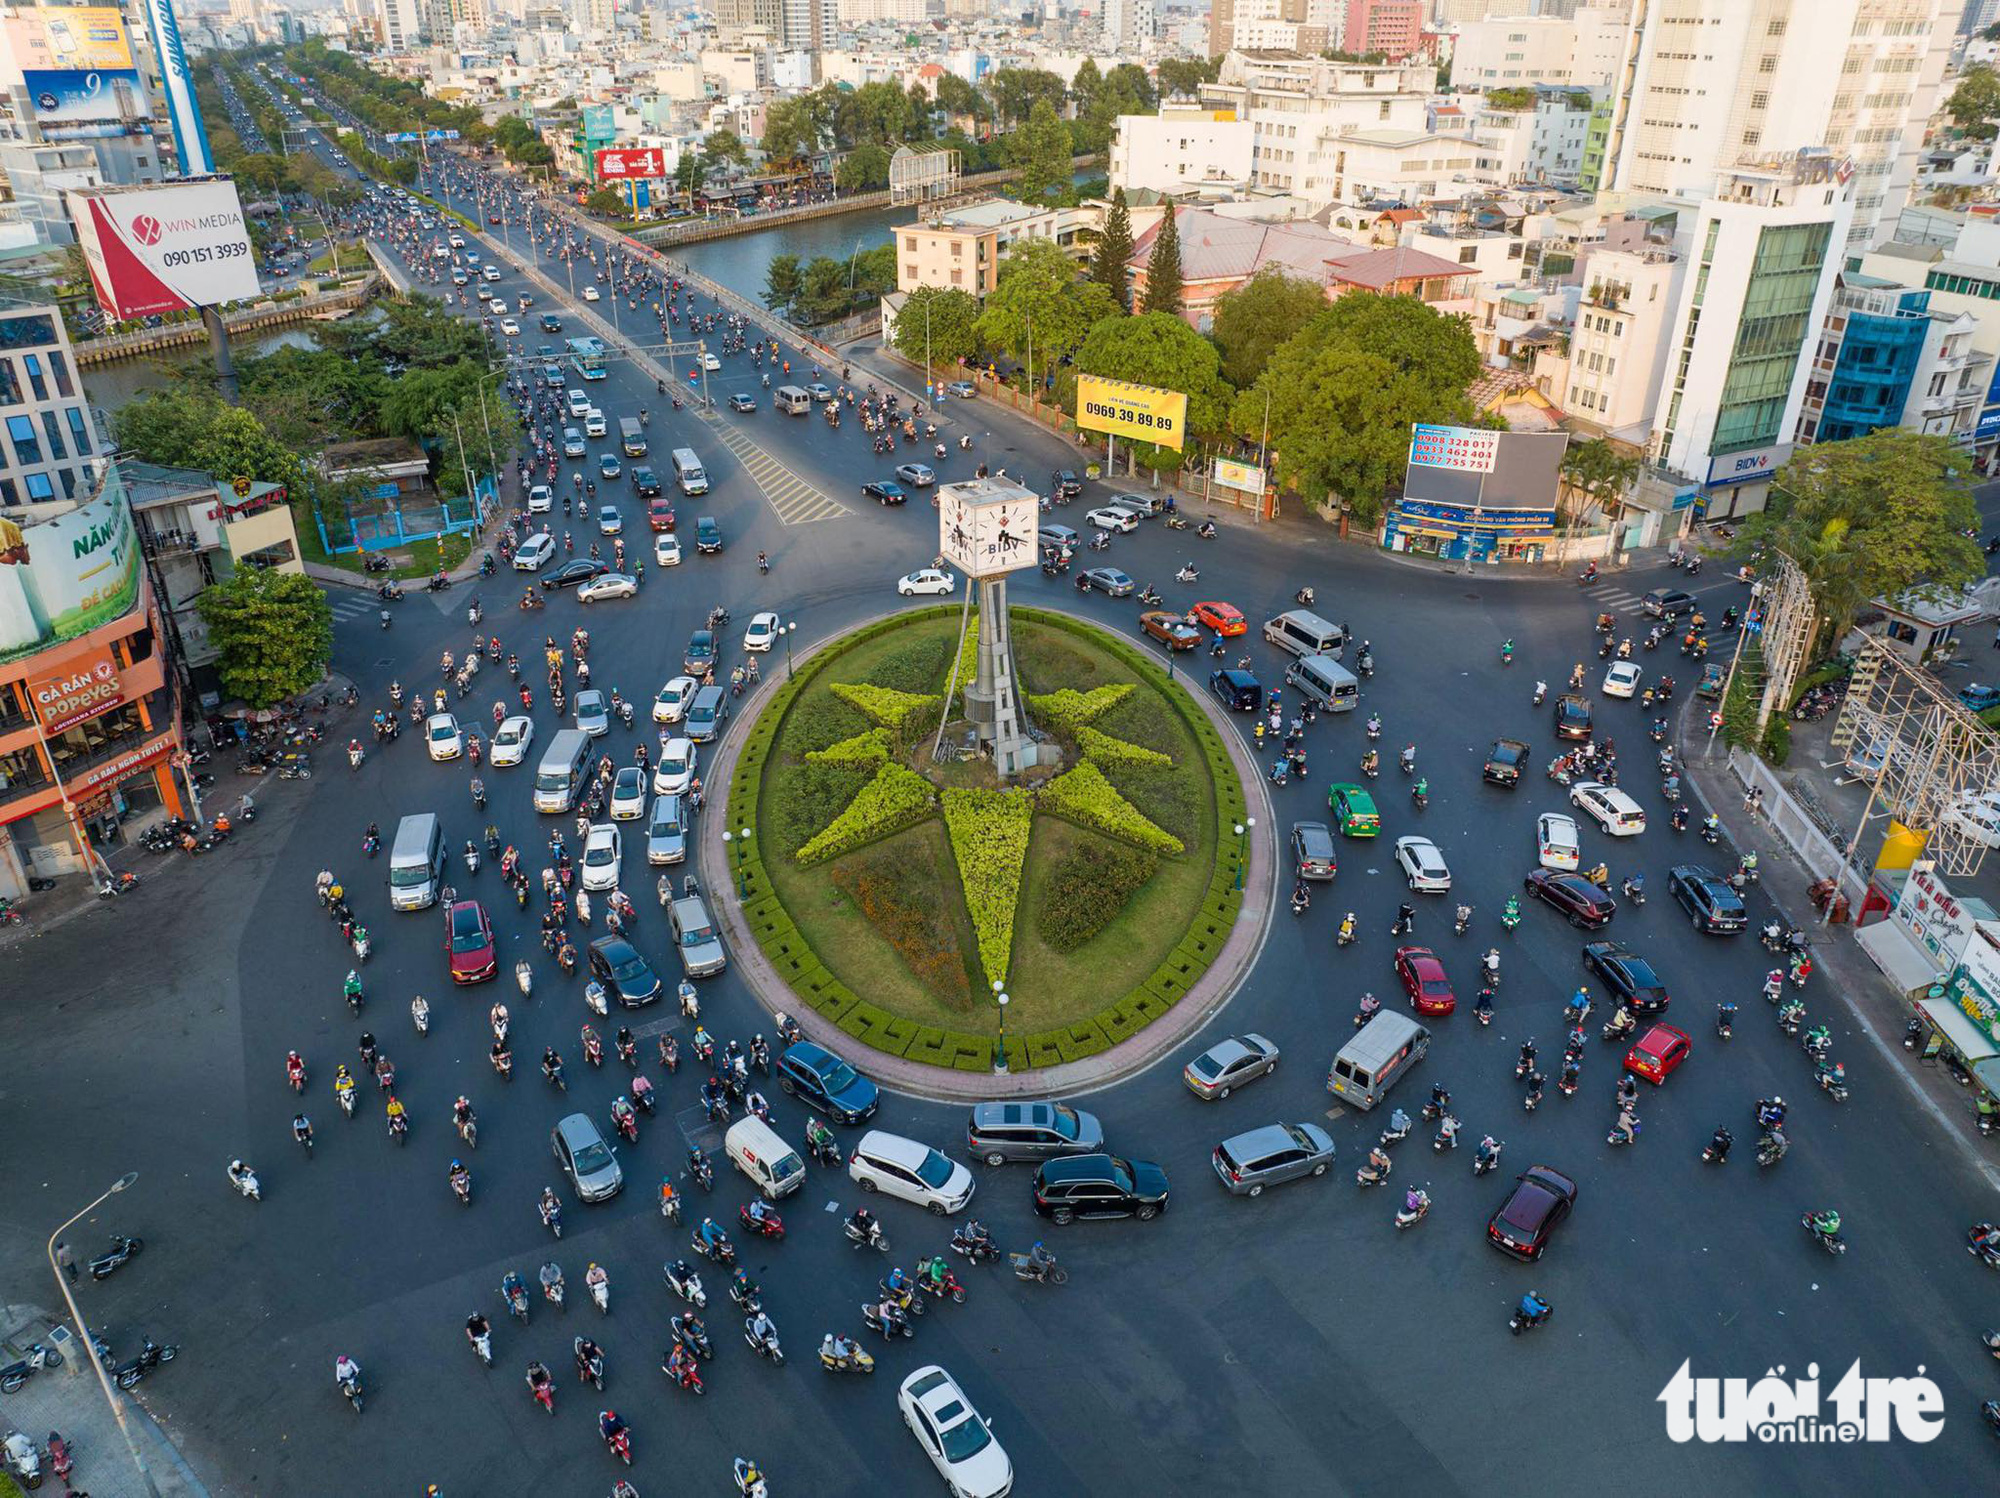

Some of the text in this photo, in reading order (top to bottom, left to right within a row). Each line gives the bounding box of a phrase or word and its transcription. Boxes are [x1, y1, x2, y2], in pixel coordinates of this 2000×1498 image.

[164, 212, 242, 234] WIN MEDIA
[163, 241, 248, 268] 090 151 3939
[1086, 402, 1172, 431] 0969.39.89.89
[1417, 434, 1446, 445] 0908
[1448, 437, 1470, 448] 328
[1472, 440, 1494, 449] 017
[1416, 444, 1492, 460] 0933 462 404
[1415, 454, 1490, 469] 0977 755 751
[1735, 456, 1760, 471] BIDV
[988, 539, 1019, 555] BIDV
[38, 672, 92, 704] GÀ RÁN
[53, 711, 89, 732] LOUISIANA
[118, 754, 140, 770] NGON
